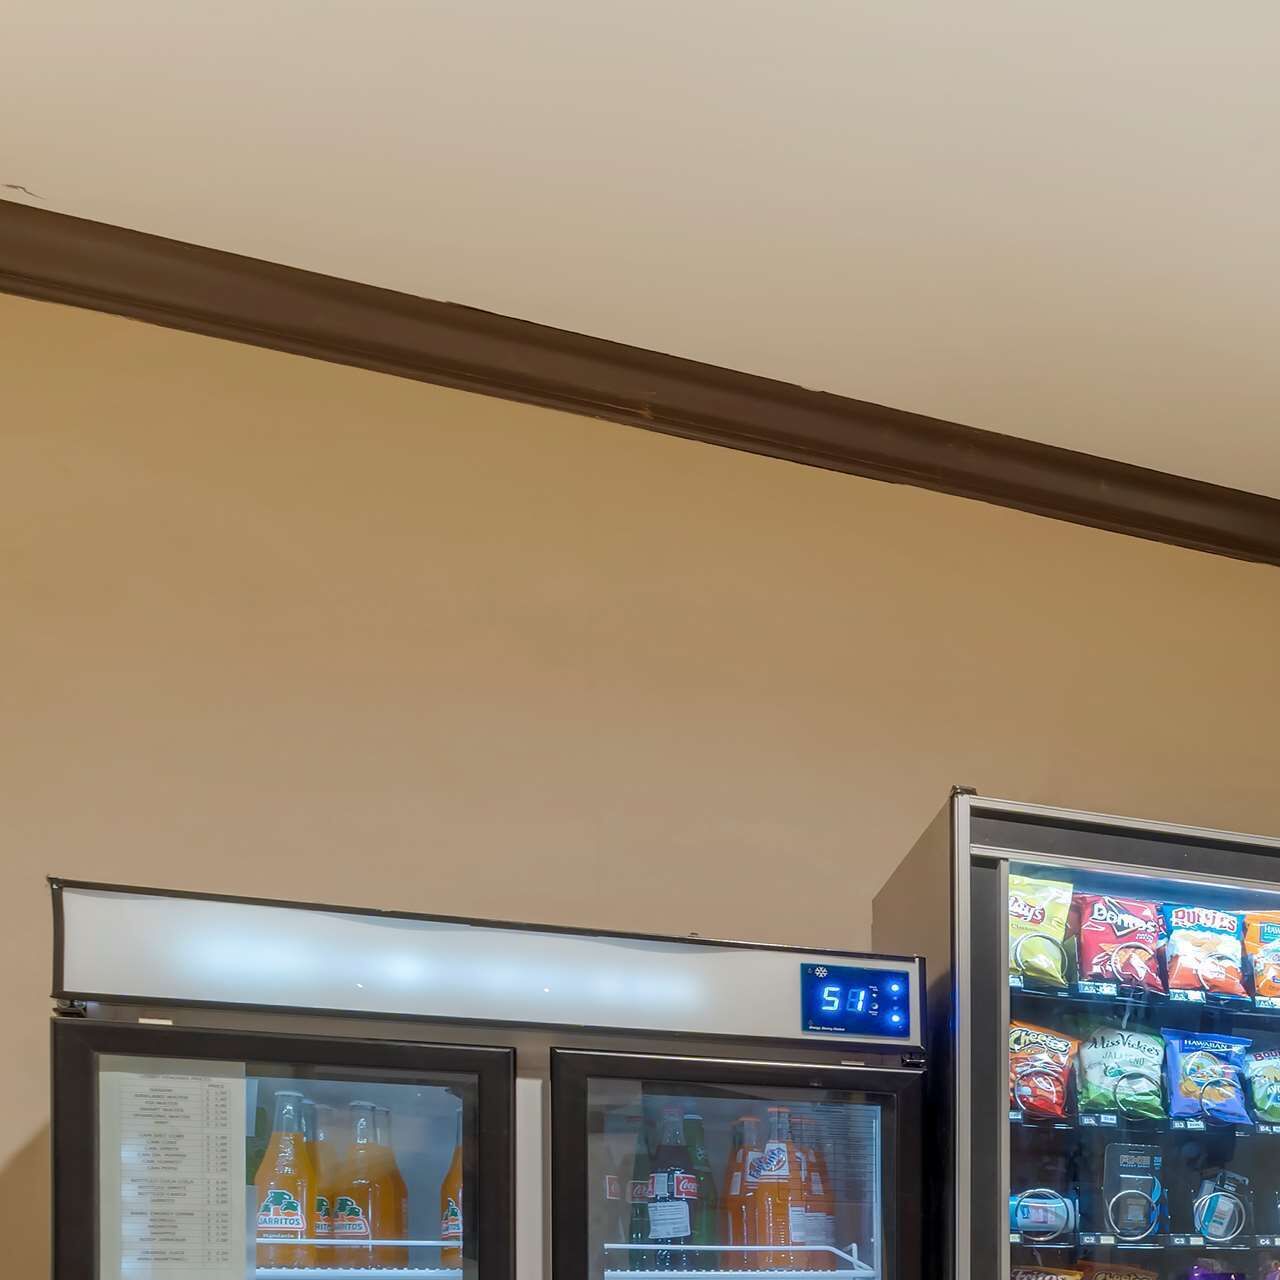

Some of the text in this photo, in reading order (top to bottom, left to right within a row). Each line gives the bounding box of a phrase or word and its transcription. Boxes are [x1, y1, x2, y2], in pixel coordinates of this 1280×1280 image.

[822, 986, 865, 1011] 51
[1088, 1036, 1120, 1050] Miss
[258, 1216, 301, 1226] JARRITOS
